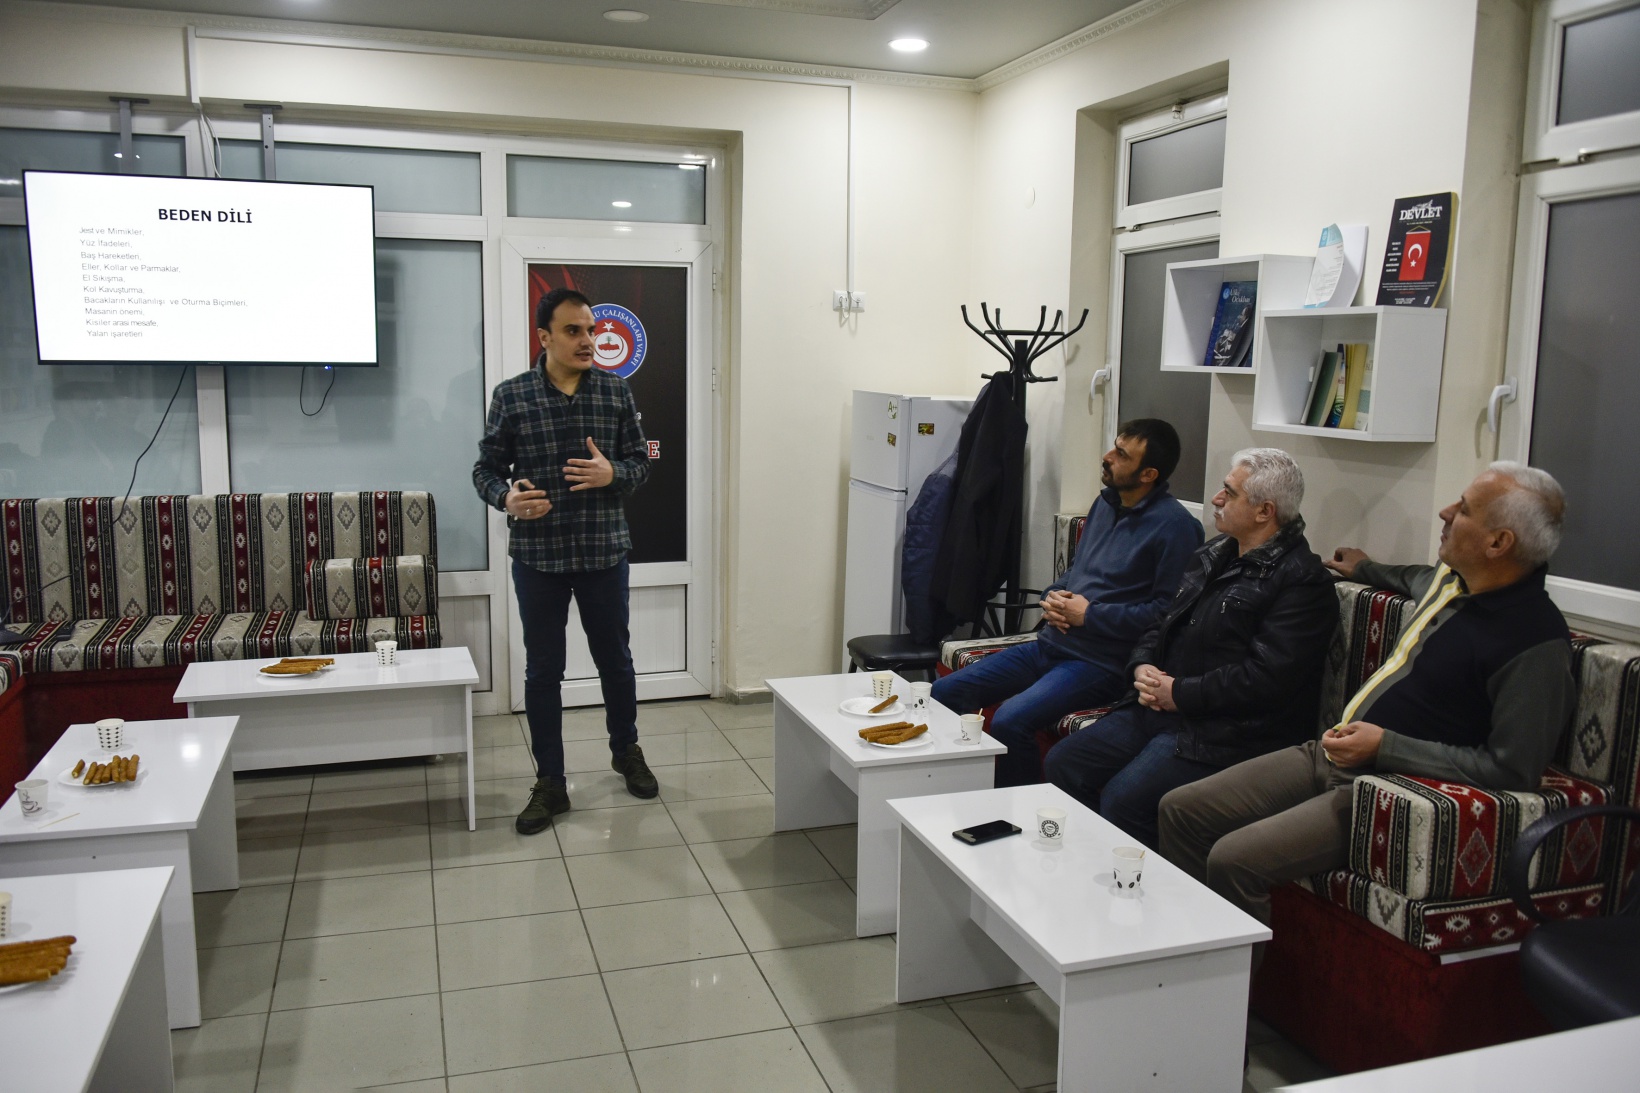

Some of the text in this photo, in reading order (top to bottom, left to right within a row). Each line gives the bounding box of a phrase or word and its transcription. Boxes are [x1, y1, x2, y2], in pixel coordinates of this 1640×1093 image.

[158, 208, 252, 223] BEDEN DİLİ
[1399, 206, 1443, 221] DEVLET
[81, 252, 96, 260] Baş
[630, 343, 643, 366] VAKFI
